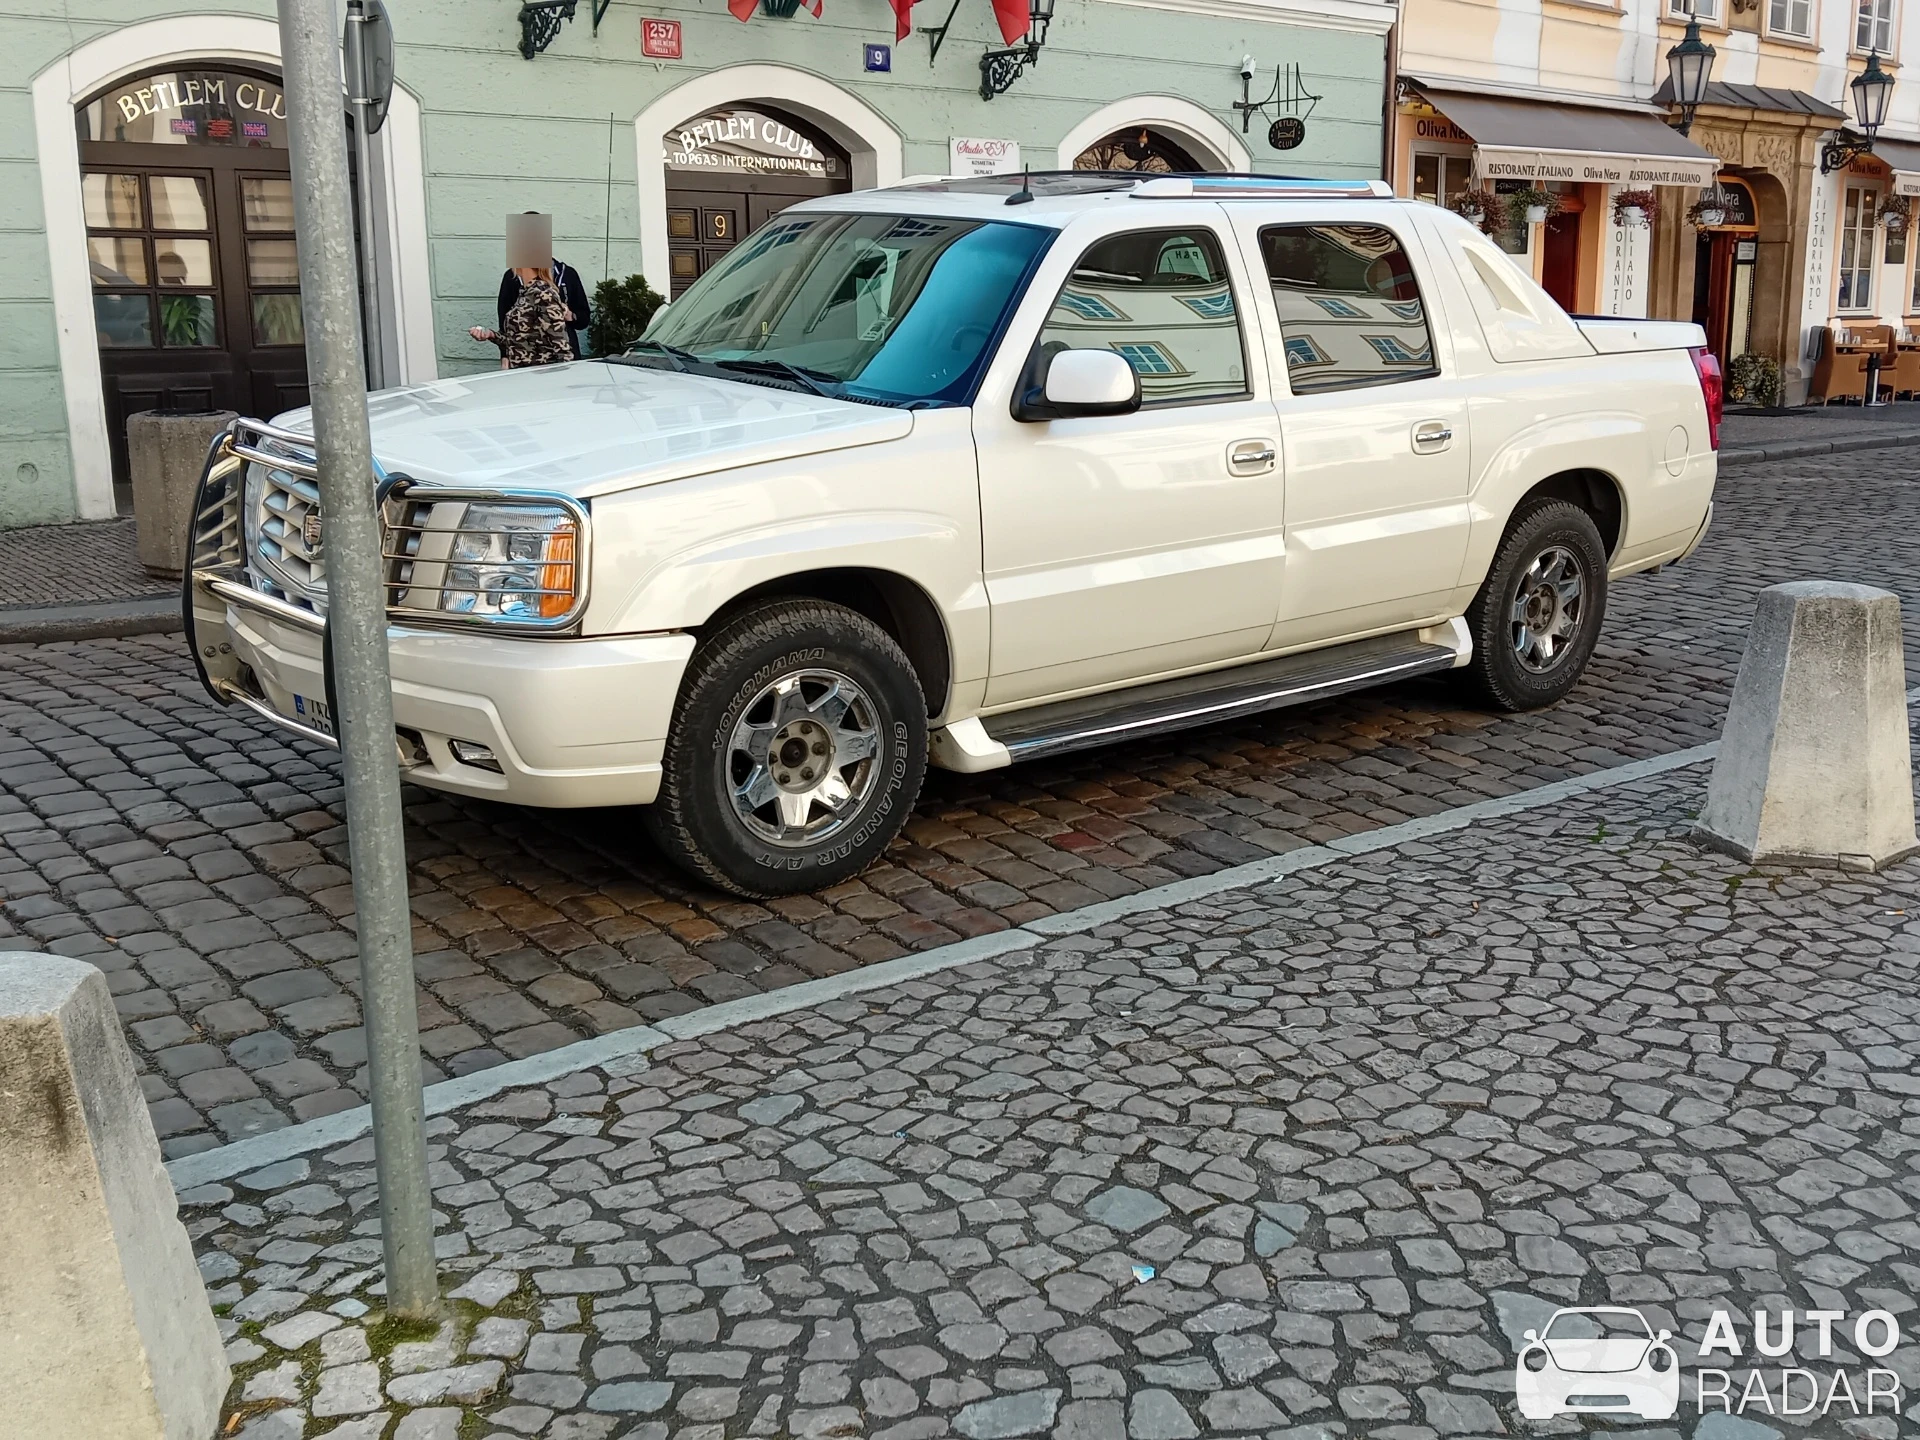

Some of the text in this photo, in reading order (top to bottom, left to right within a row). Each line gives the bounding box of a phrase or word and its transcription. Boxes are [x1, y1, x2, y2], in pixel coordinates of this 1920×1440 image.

[650, 23, 674, 39] 257
[874, 50, 883, 66] 9
[116, 79, 288, 124] BETLEM CLU
[679, 116, 814, 159] BETLEM CLUB
[1416, 119, 1474, 140] Oliva Ne
[957, 140, 984, 156] Studio
[672, 151, 719, 166] TOPGAS
[722, 155, 809, 171] INTERNATIONAL
[1488, 163, 1574, 178] RISTORANTE ITALIANO
[1583, 167, 1621, 180] Oliva Nera
[1629, 170, 1701, 183] RISTORANTE ITALIANO
[1716, 181, 1739, 205] Nera
[1903, 184, 1920, 193] RISTOR
[714, 215, 726, 237] 9
[1808, 187, 1821, 310] RISTORANTE
[1815, 200, 1826, 298] ITALIANO
[712, 647, 824, 751] YOKOHAMA
[755, 721, 908, 871] GEOLANDAR A/T
